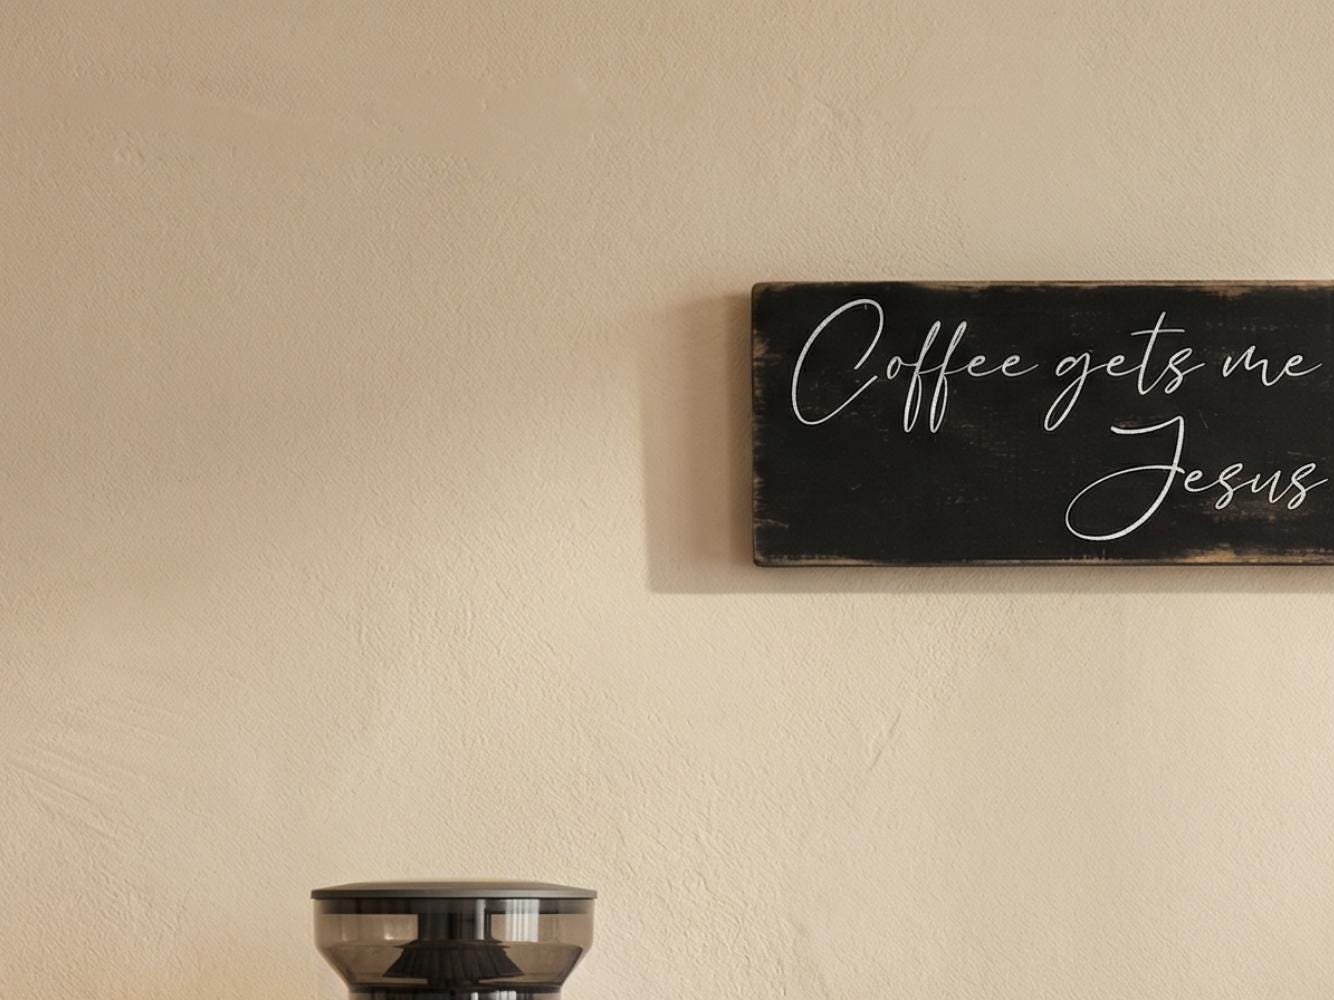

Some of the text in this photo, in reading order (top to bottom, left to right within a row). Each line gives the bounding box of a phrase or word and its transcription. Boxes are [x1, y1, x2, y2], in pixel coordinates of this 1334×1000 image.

[790, 297, 1040, 435] Coffee
[1043, 311, 1206, 432] gets
[1222, 345, 1323, 387] me
[1064, 415, 1330, 541] Jesus
